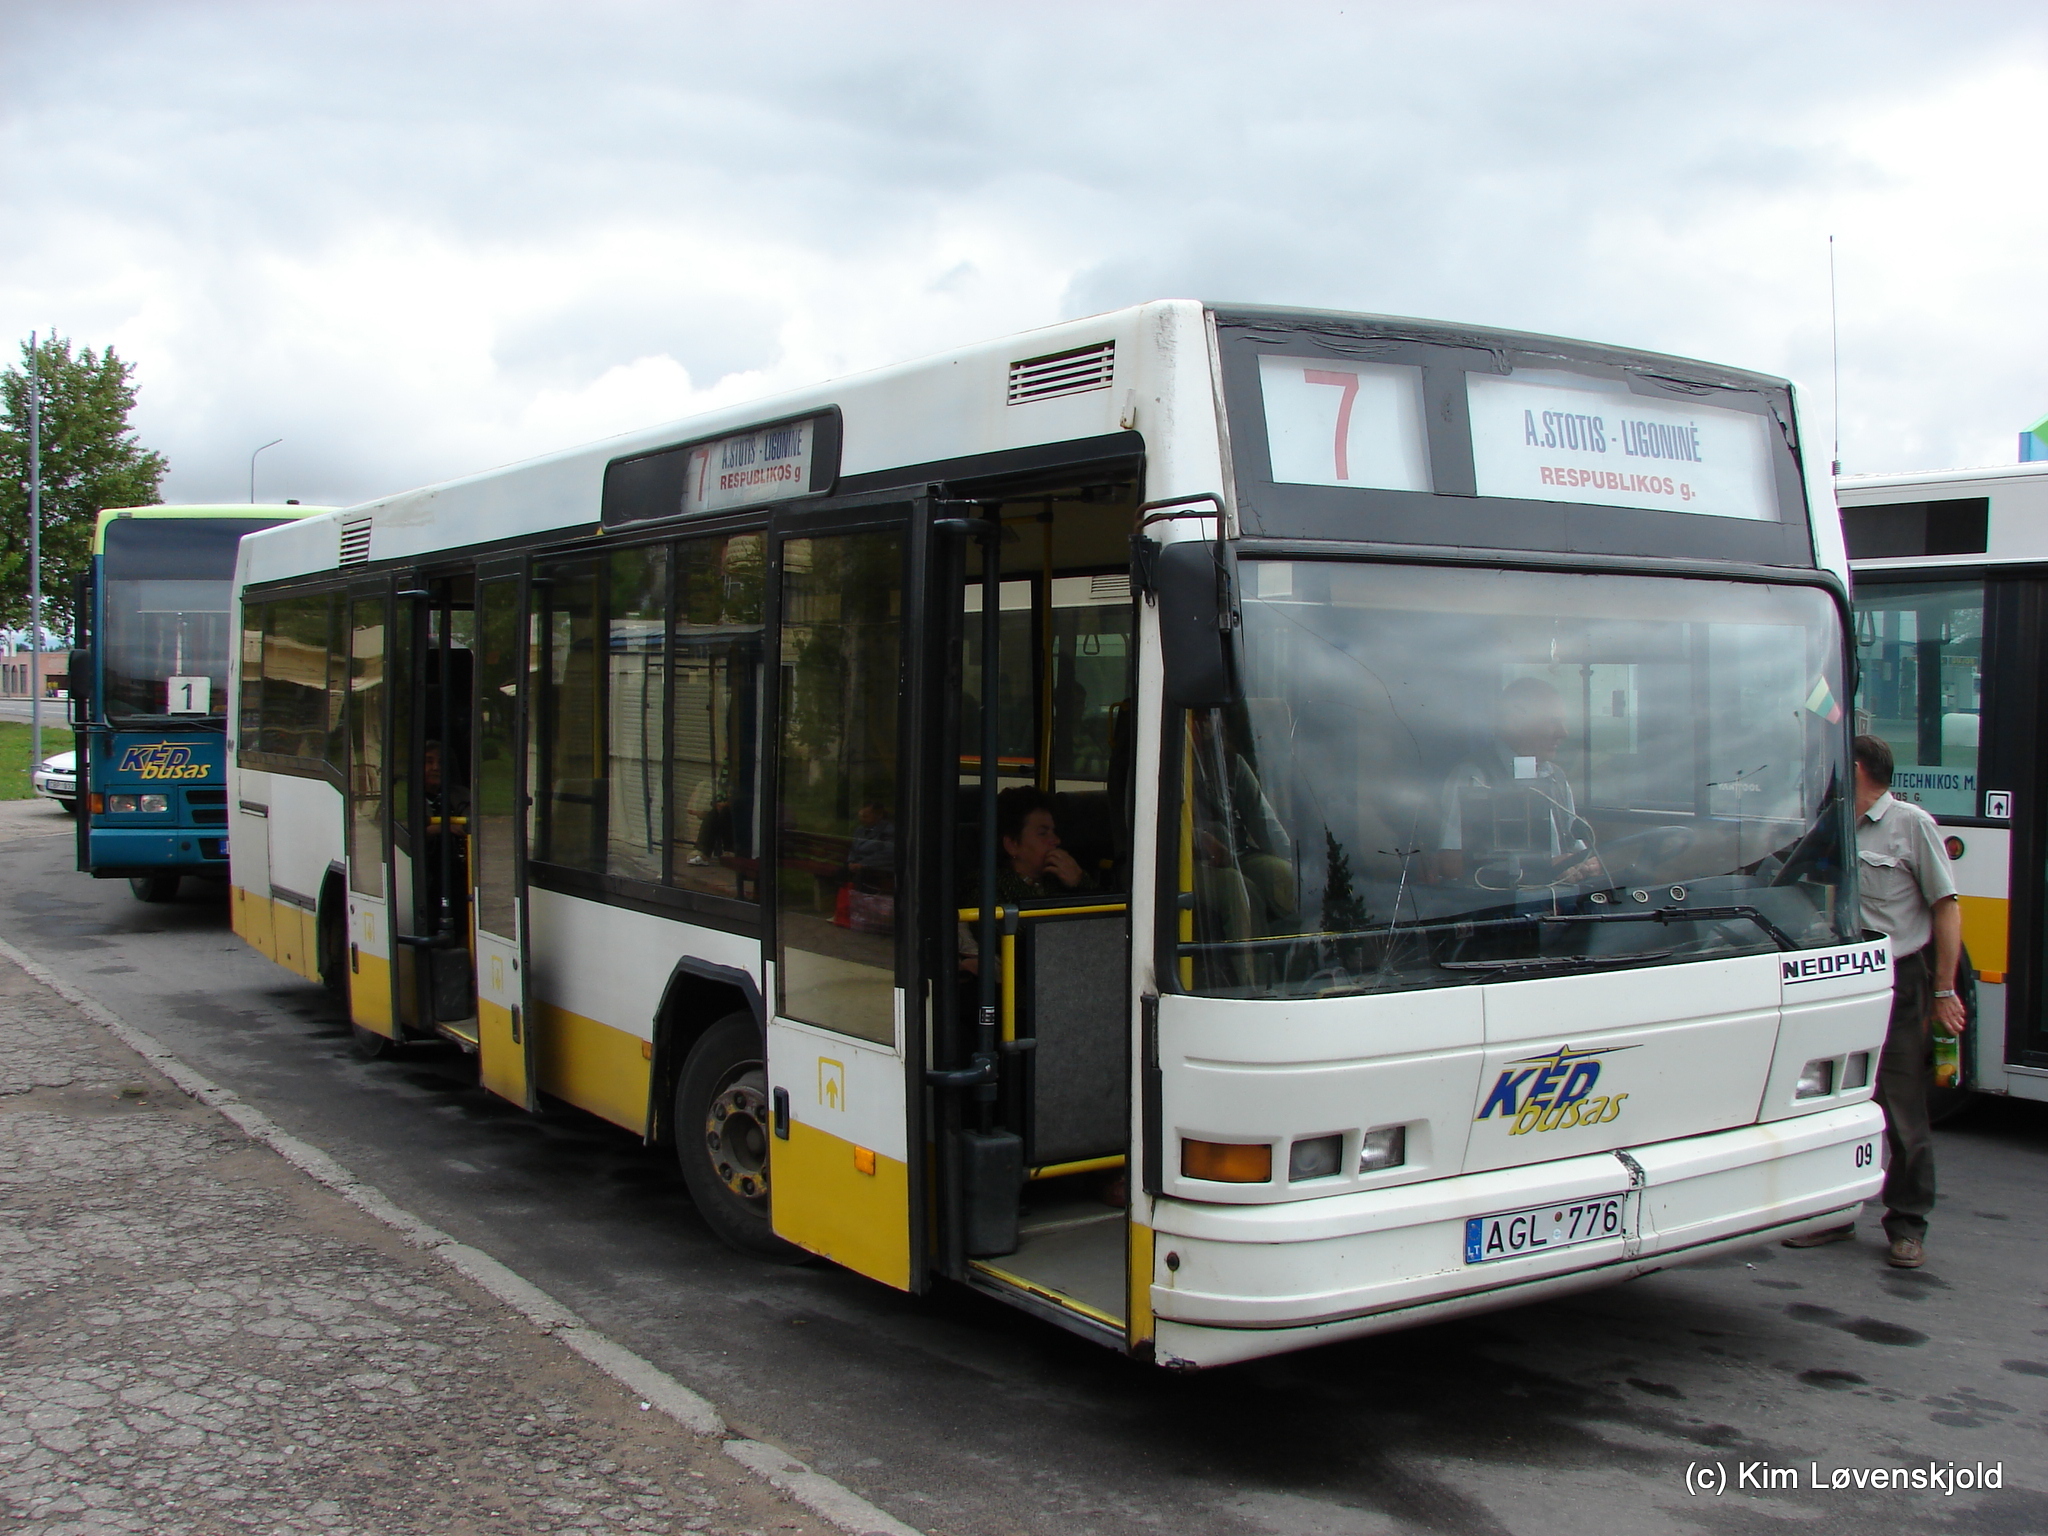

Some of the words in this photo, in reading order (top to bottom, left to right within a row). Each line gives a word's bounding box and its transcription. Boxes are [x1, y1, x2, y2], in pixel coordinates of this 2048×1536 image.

[1303, 369, 1359, 480] 7
[1524, 409, 1606, 453] A.STOTIS
[1621, 421, 1702, 462] LIGONINĖ
[696, 451, 710, 502] 7
[720, 464, 792, 490] RESPUBLIKOS
[1540, 466, 1674, 495] RESPUBLIKOS
[1680, 483, 1696, 500] g.
[180, 683, 193, 710] 1
[140, 761, 211, 780] busas
[1890, 773, 1959, 790] ITECHNIKOS
[1782, 949, 1887, 980] NEOPLAN
[1508, 1093, 1629, 1136] busas
[1855, 1142, 1872, 1168] 09
[1486, 1214, 1548, 1255] AGL
[1568, 1200, 1618, 1239] 776
[1467, 1245, 1480, 1256] LT
